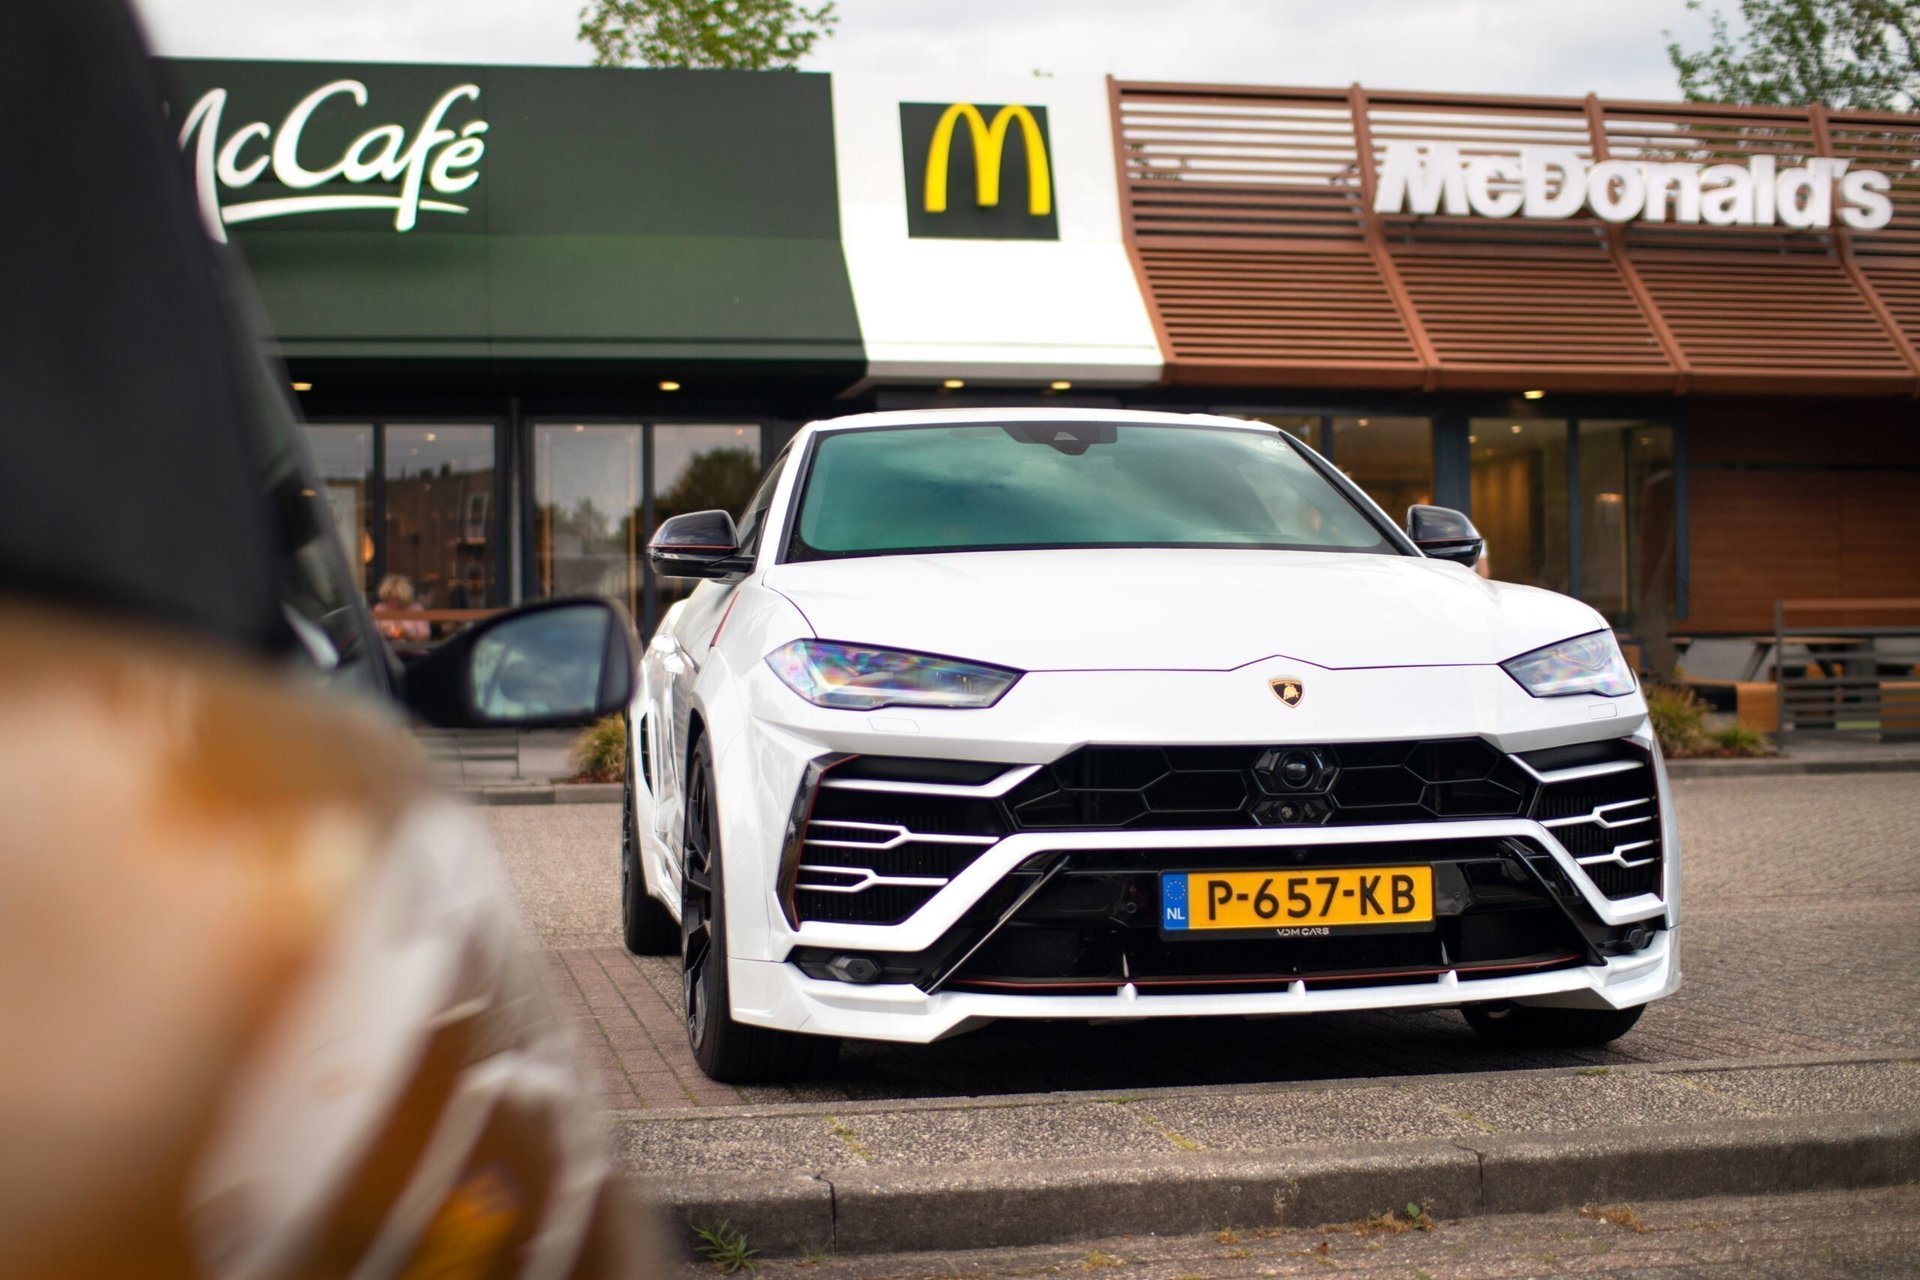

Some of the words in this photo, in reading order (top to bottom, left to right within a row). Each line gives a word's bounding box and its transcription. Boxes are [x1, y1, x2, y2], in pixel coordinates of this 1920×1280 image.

[1374, 140, 1893, 230] McDonald's
[1207, 874, 1416, 921] P-657-KB
[1166, 907, 1186, 920] NL
[1276, 928, 1300, 937] VDM
[1301, 927, 1330, 936] CARS
